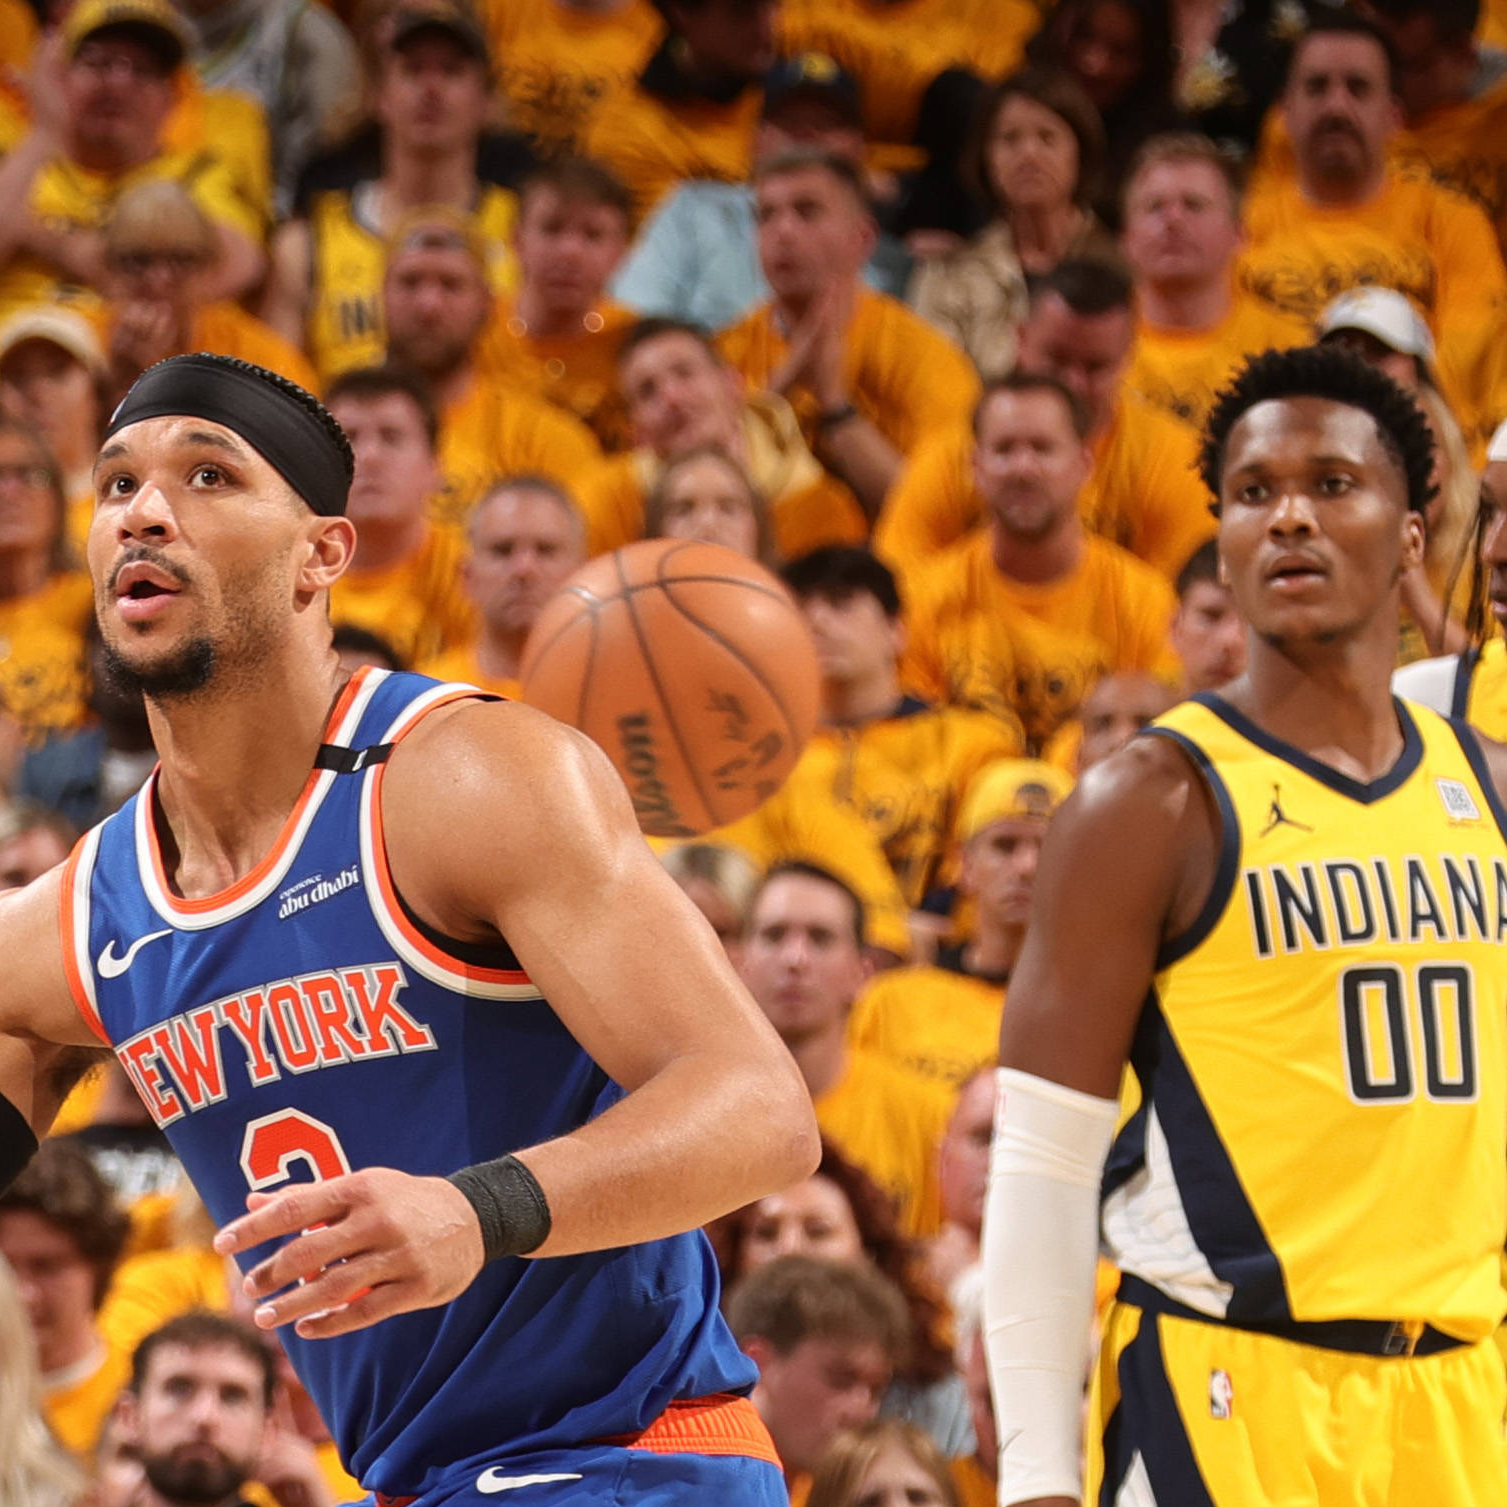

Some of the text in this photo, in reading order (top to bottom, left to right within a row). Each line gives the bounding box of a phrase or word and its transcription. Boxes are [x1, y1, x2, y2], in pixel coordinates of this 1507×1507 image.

[278, 863, 360, 920] abu dhabi
[217, 961, 439, 1089] YORK
[1338, 957, 1481, 1107] 00
